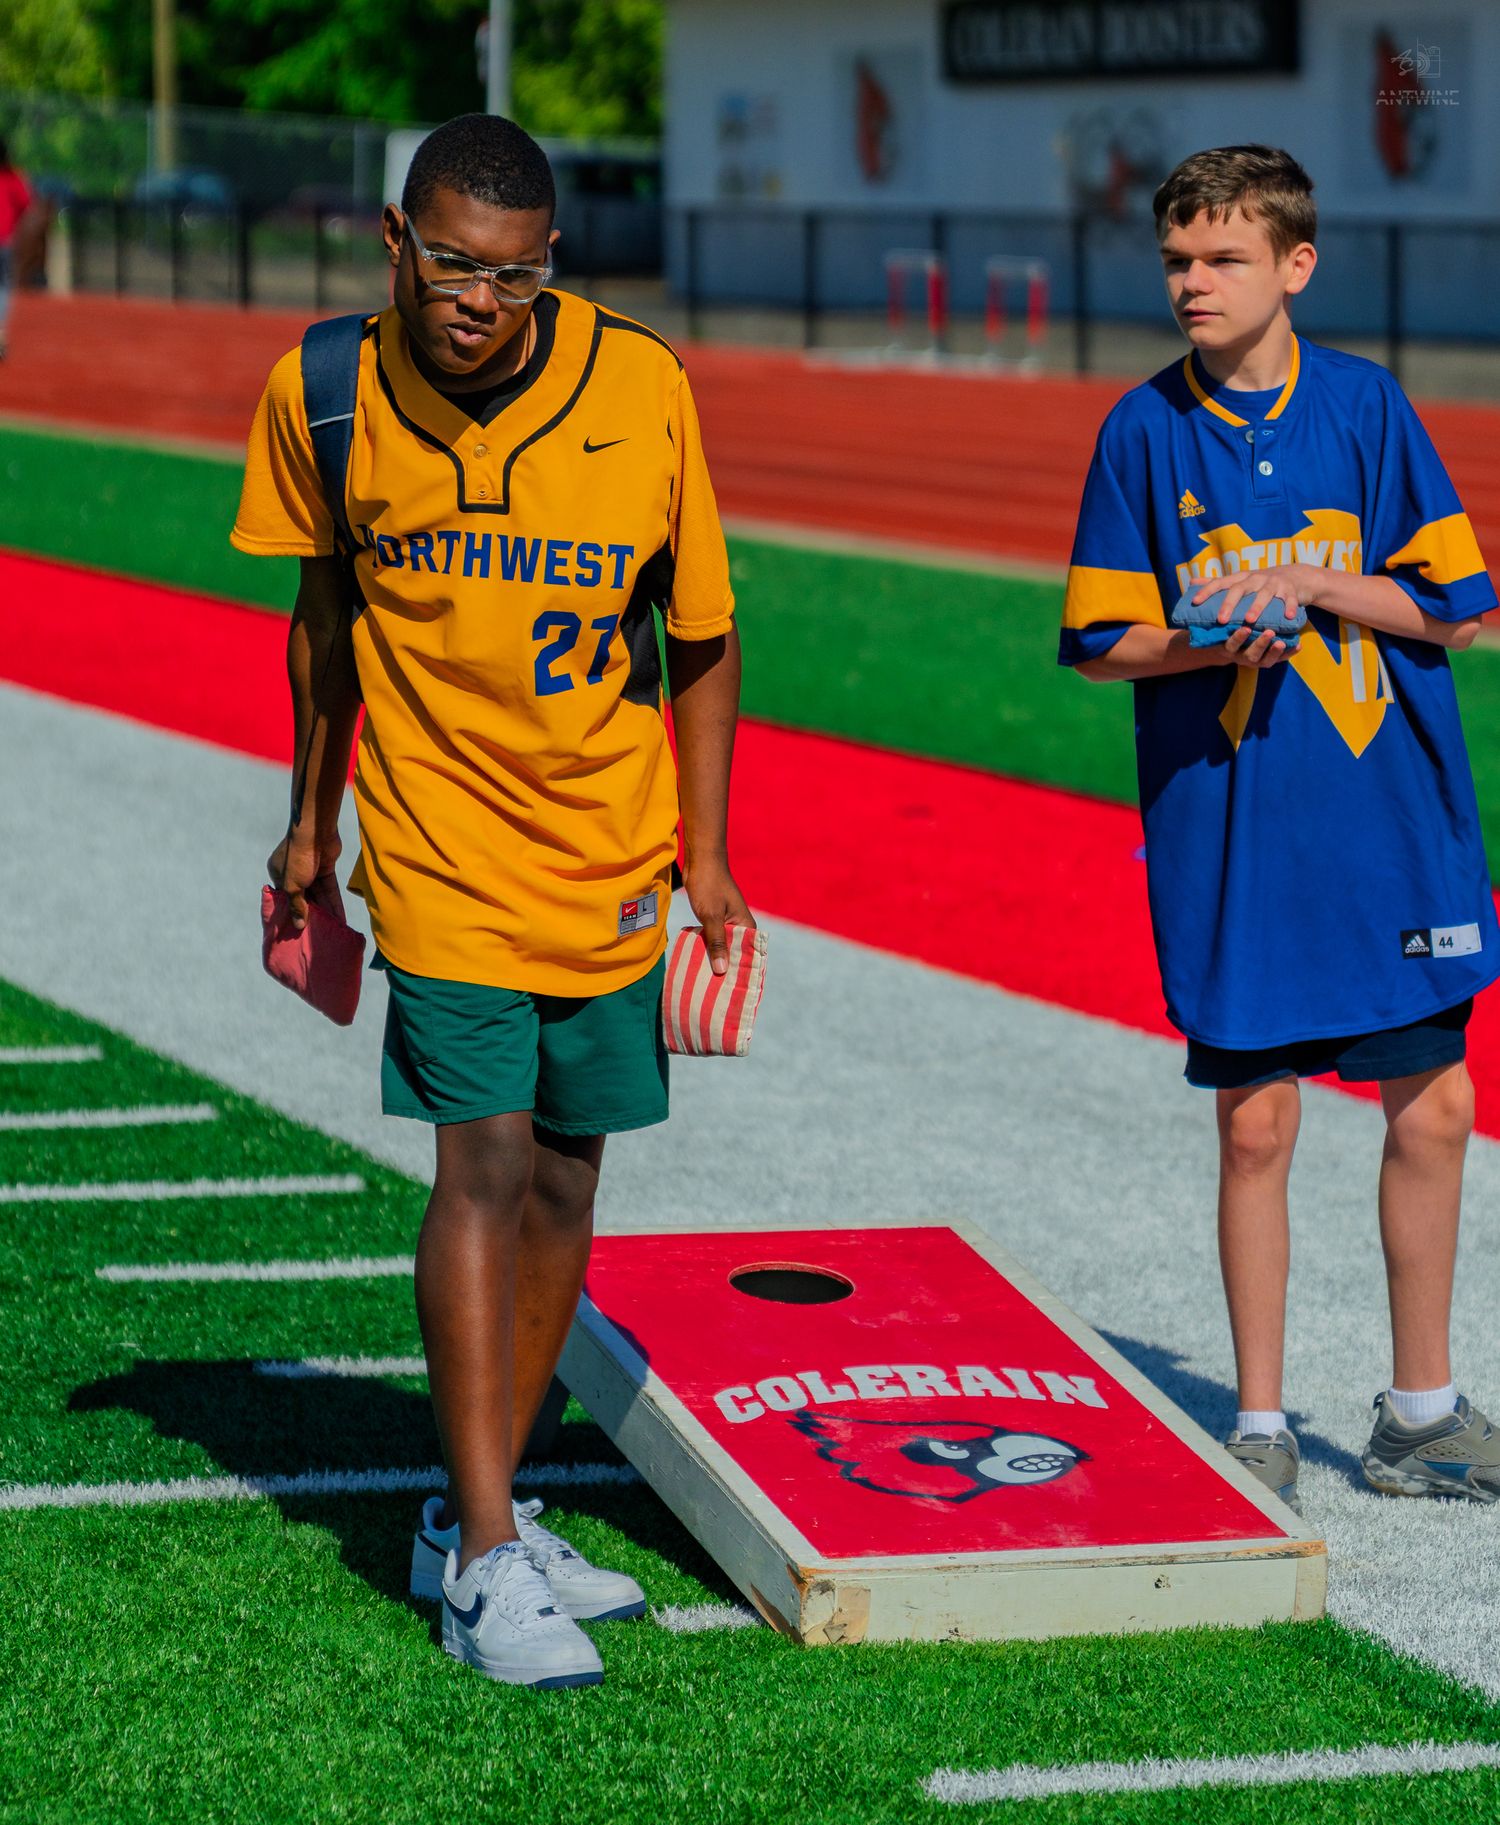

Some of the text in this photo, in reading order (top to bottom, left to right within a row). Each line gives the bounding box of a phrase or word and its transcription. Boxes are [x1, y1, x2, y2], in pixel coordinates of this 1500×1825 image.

[1178, 540, 1363, 592] NORTHWE
[1404, 945, 1430, 954] adidas
[1438, 935, 1454, 949] 44
[713, 1364, 1109, 1424] COLERAIN
